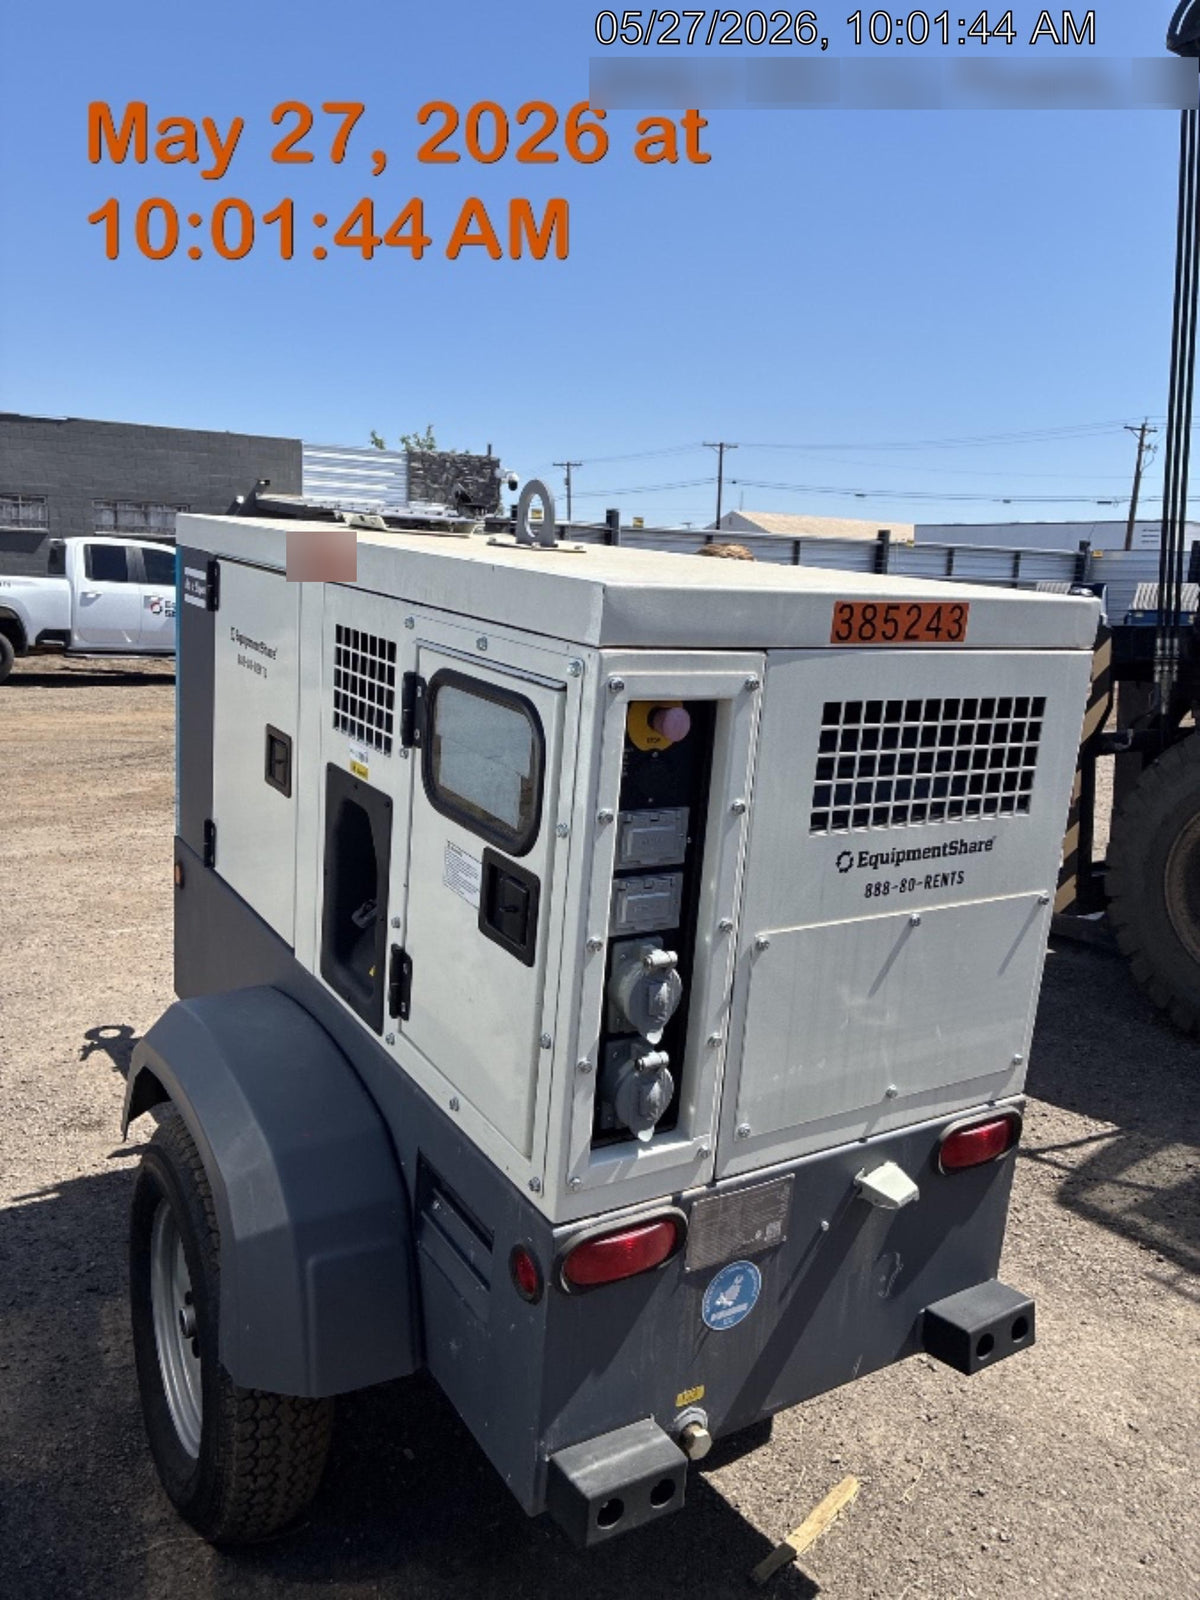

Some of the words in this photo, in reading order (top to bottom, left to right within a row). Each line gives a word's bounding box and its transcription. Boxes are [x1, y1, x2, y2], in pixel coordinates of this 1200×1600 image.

[835, 602, 966, 641] 385243
[856, 838, 994, 870] EquipmentShare
[864, 870, 965, 899] 888-80-RENTS
